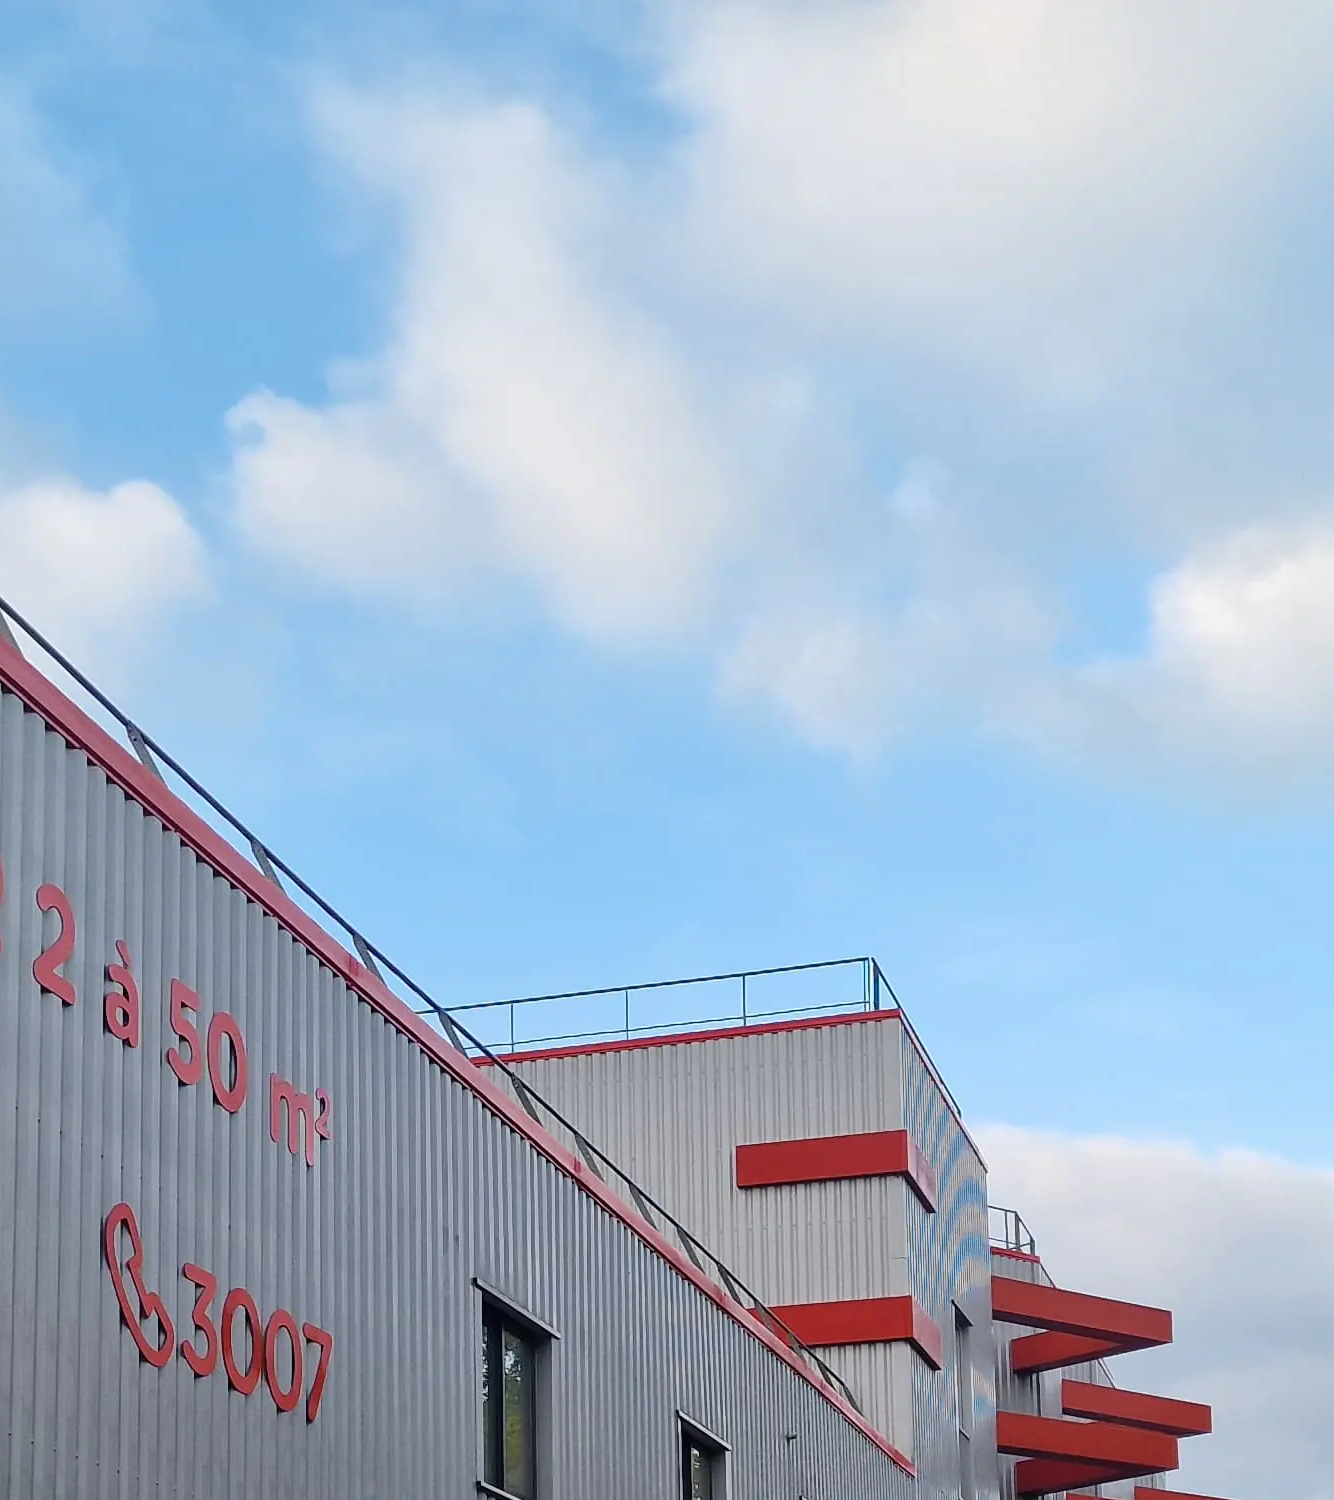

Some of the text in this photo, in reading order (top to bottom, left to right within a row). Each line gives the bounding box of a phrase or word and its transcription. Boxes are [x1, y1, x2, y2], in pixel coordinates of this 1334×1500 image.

[33, 883, 76, 1006] 2
[104, 939, 140, 1048] à
[167, 978, 248, 1114] 50
[181, 1262, 333, 1424] 3007
